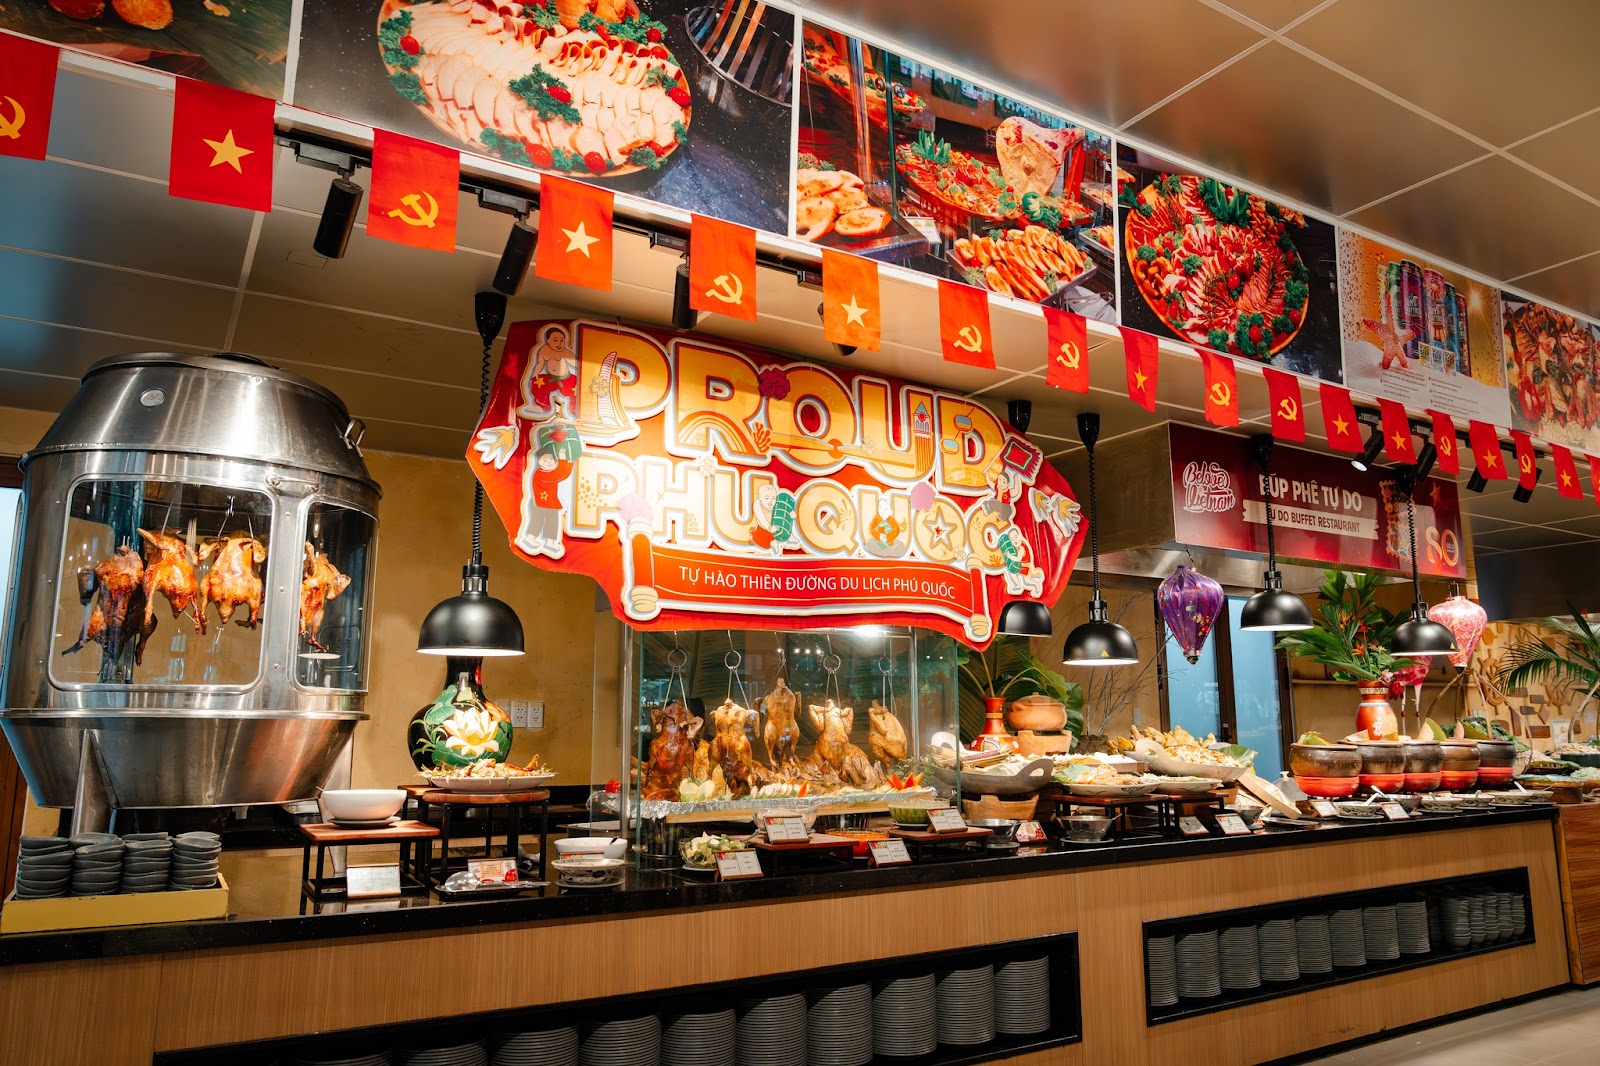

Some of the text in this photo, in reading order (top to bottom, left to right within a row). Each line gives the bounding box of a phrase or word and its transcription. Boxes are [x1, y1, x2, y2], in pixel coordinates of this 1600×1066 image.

[577, 323, 1005, 490] PROUD
[573, 454, 1013, 570] PHU QUOC
[1292, 480, 1319, 505] PHÊ
[1321, 486, 1339, 511] TỰ
[1342, 489, 1362, 512] DO
[1278, 509, 1289, 522] DO
[1291, 512, 1316, 527] BUFFET
[1318, 516, 1361, 533] RESTAURANT
[679, 565, 956, 599] TỰ HÀO THIÊN ĐƯỜNG DU LỊCH PHÚ QUỐC
